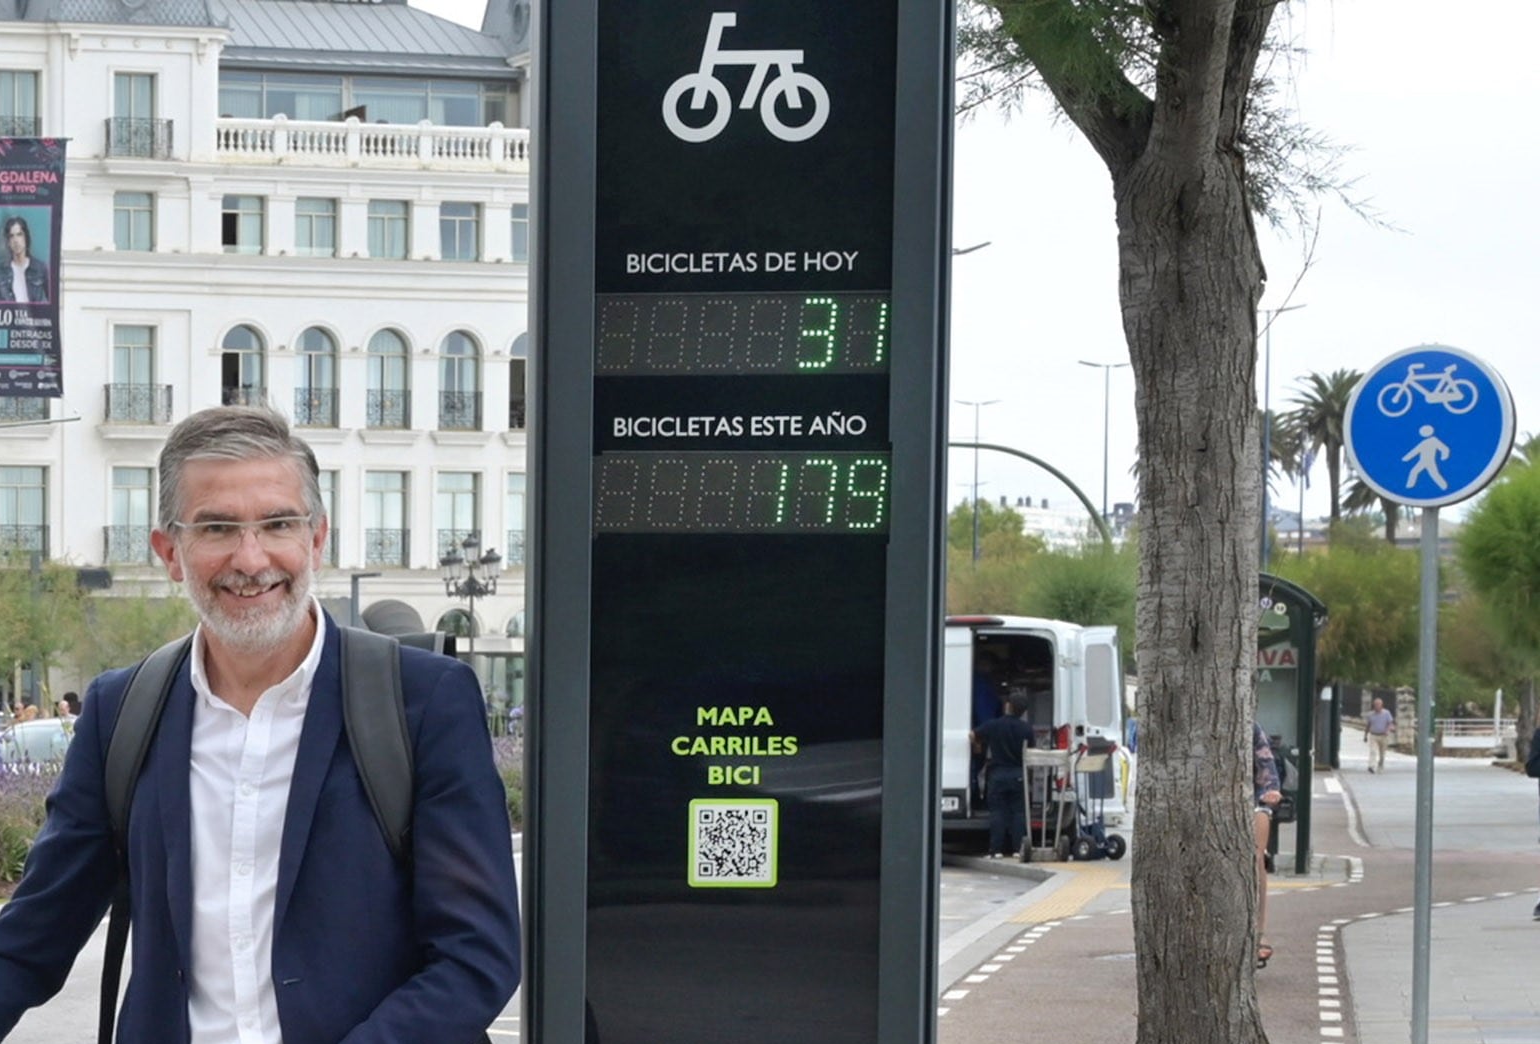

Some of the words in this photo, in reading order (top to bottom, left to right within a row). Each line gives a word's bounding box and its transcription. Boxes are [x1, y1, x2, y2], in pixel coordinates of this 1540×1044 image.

[1, 185, 13, 193] EN
[16, 185, 37, 193] VIVO
[626, 253, 758, 273] BICICLETAS
[765, 252, 797, 272] DE
[804, 251, 859, 271] HOY
[10, 330, 52, 339] ENTRADAS
[798, 298, 887, 369] 31
[10, 340, 38, 349] DESDE
[613, 417, 744, 437] BICICLETAS
[751, 415, 803, 436] ESTE
[809, 411, 868, 436] AÑO
[775, 458, 888, 529] 179
[696, 706, 774, 726] MAPA
[671, 736, 798, 756] CARRILES
[707, 766, 760, 785] BICI
